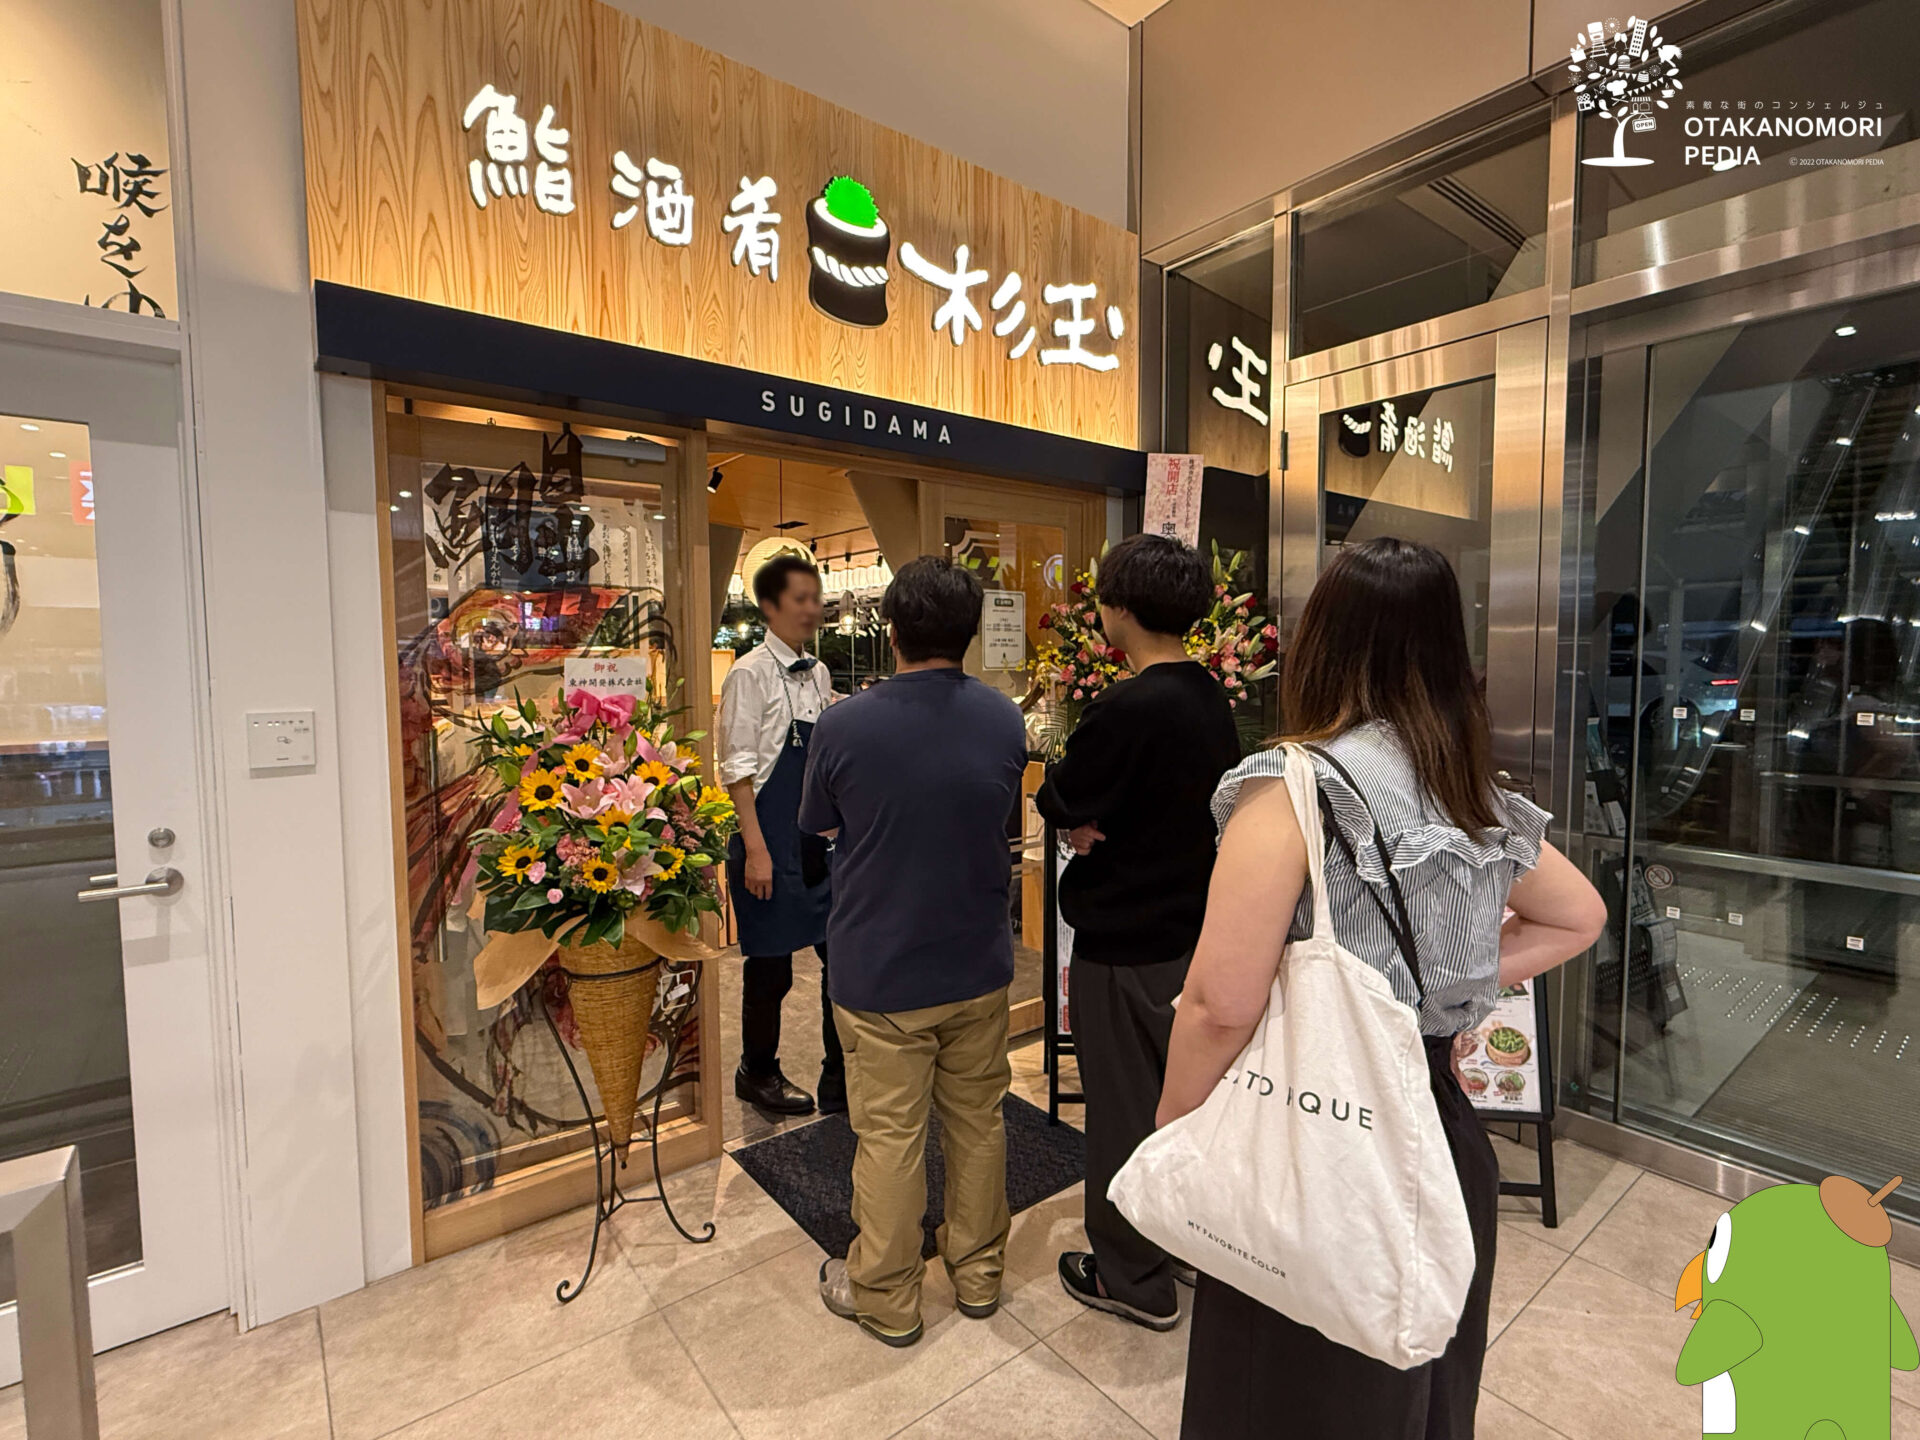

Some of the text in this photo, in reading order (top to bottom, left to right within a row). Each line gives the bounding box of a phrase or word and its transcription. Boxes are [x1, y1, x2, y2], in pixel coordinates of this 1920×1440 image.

[463, 83, 1124, 372] 鮨 酒 肴 杉玉
[761, 390, 951, 444] SUGIDAMA
[1166, 458, 1180, 496] 祝開店
[569, 678, 642, 687] 東神開発株式会社
[594, 662, 618, 673] 御祝
[1187, 1219, 1287, 1279] MY FAVORITE COLOR
